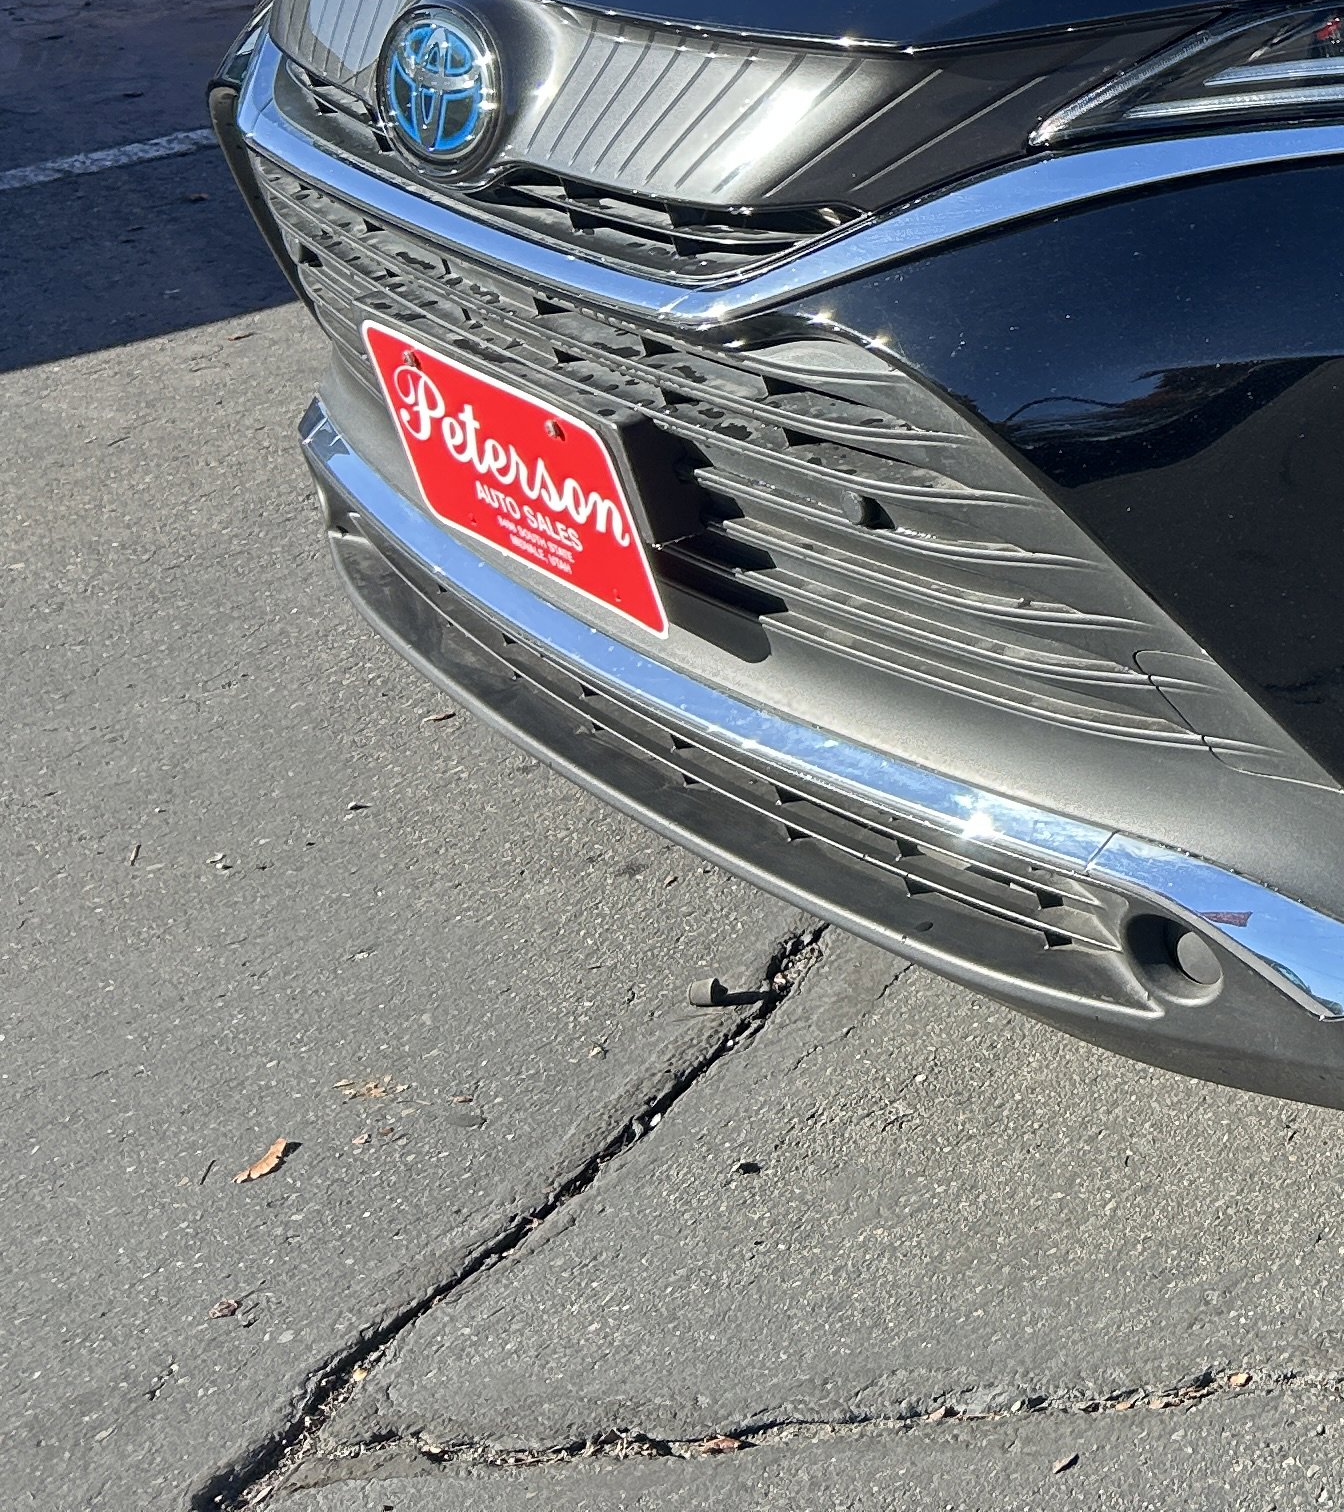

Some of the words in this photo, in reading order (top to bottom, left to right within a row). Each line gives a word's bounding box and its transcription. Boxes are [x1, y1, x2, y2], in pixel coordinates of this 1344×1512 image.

[393, 364, 631, 549] Peterson
[475, 480, 521, 520] AUTO
[523, 505, 584, 552] SALES
